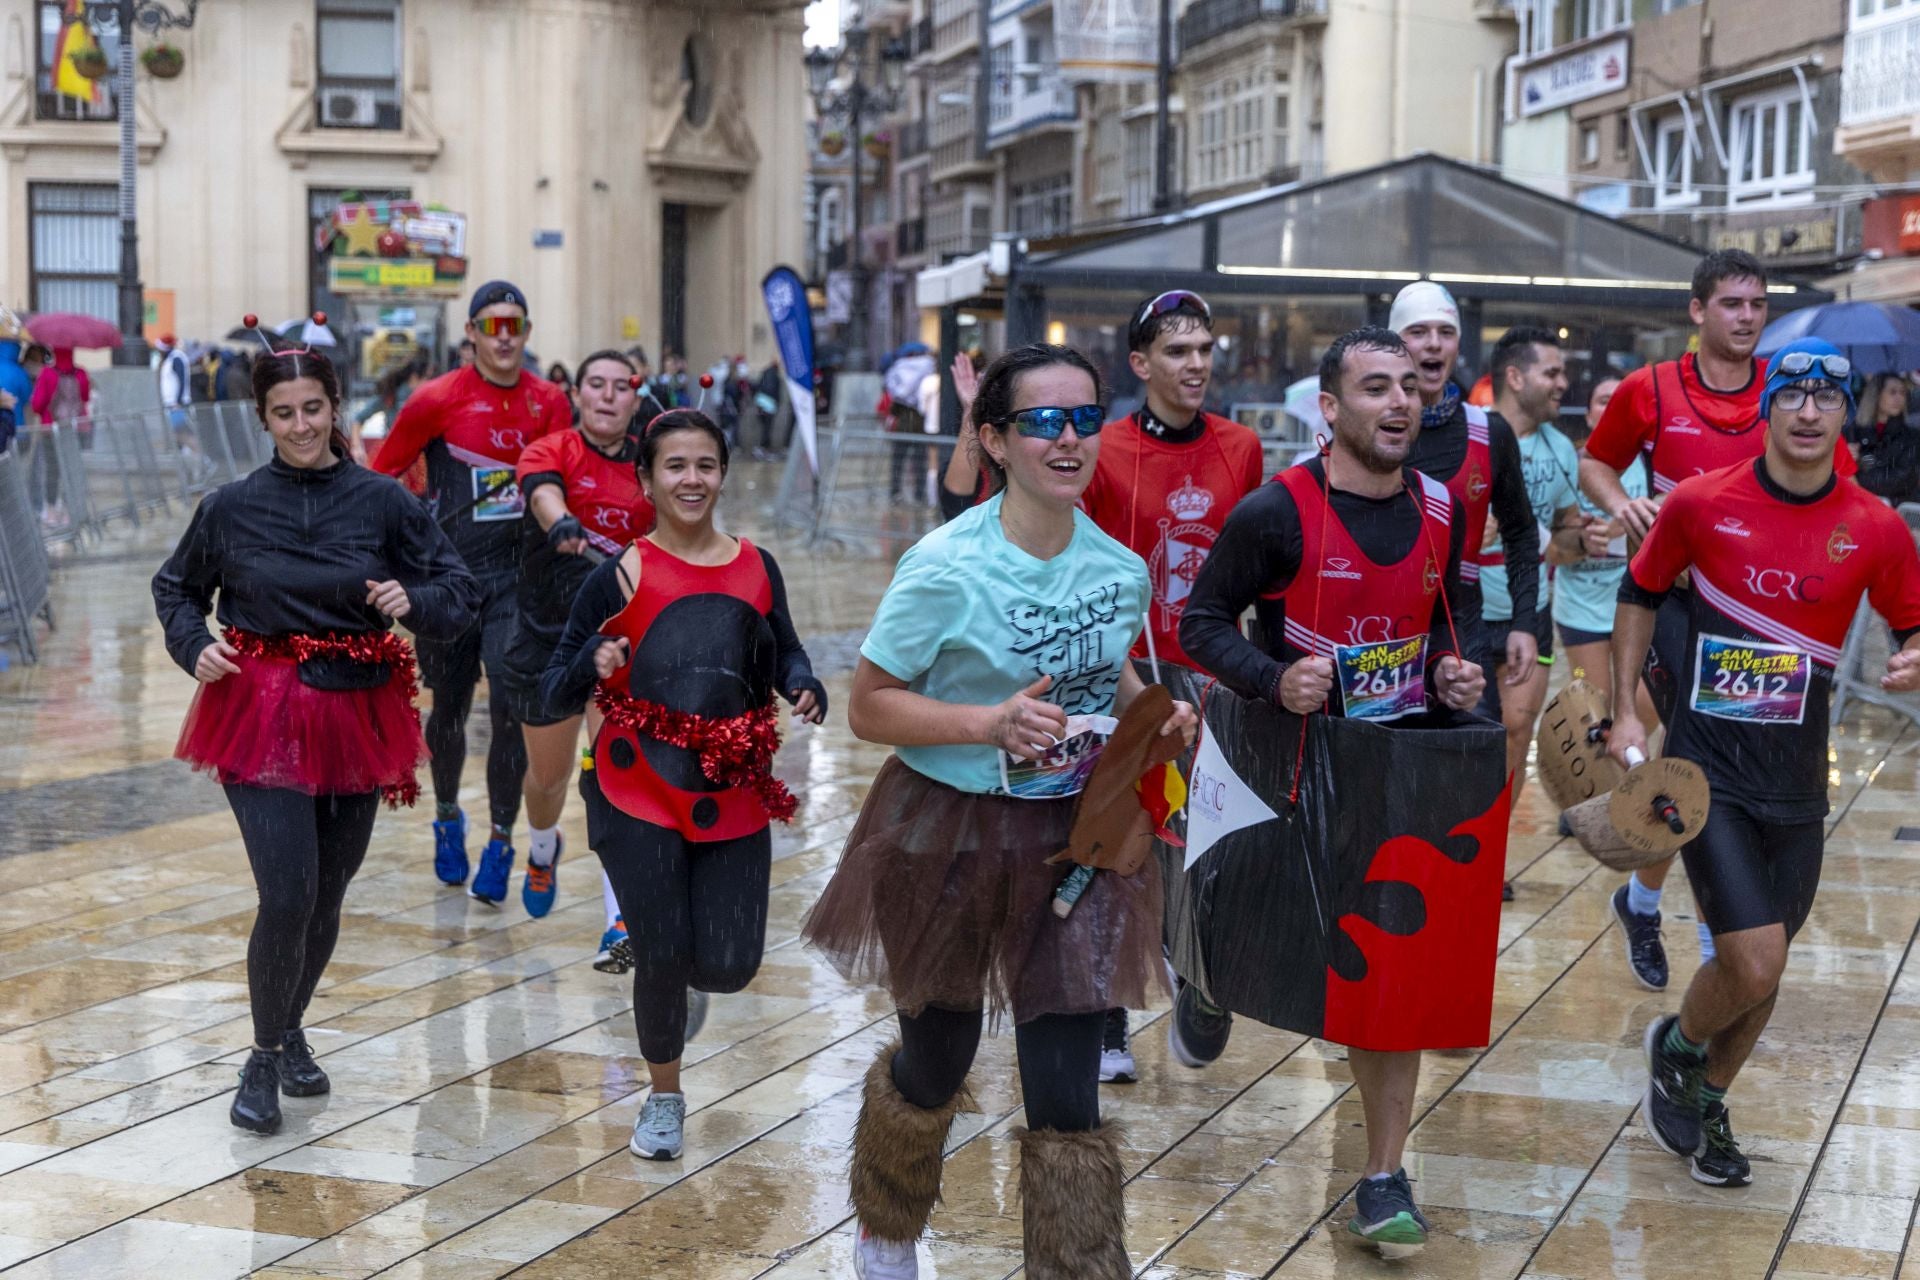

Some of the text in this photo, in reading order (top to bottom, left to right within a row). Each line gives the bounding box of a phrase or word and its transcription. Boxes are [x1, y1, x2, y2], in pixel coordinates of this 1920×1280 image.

[1742, 565, 1824, 604] RCRC
[1006, 582, 1121, 655] SAN
[1358, 637, 1422, 673] SILVESTRE
[1360, 645, 1388, 663] SAN
[1720, 654, 1799, 672] SILVESTRE
[1721, 649, 1754, 661] SAN
[1352, 664, 1412, 697] 2611
[1713, 668, 1789, 700] 2612
